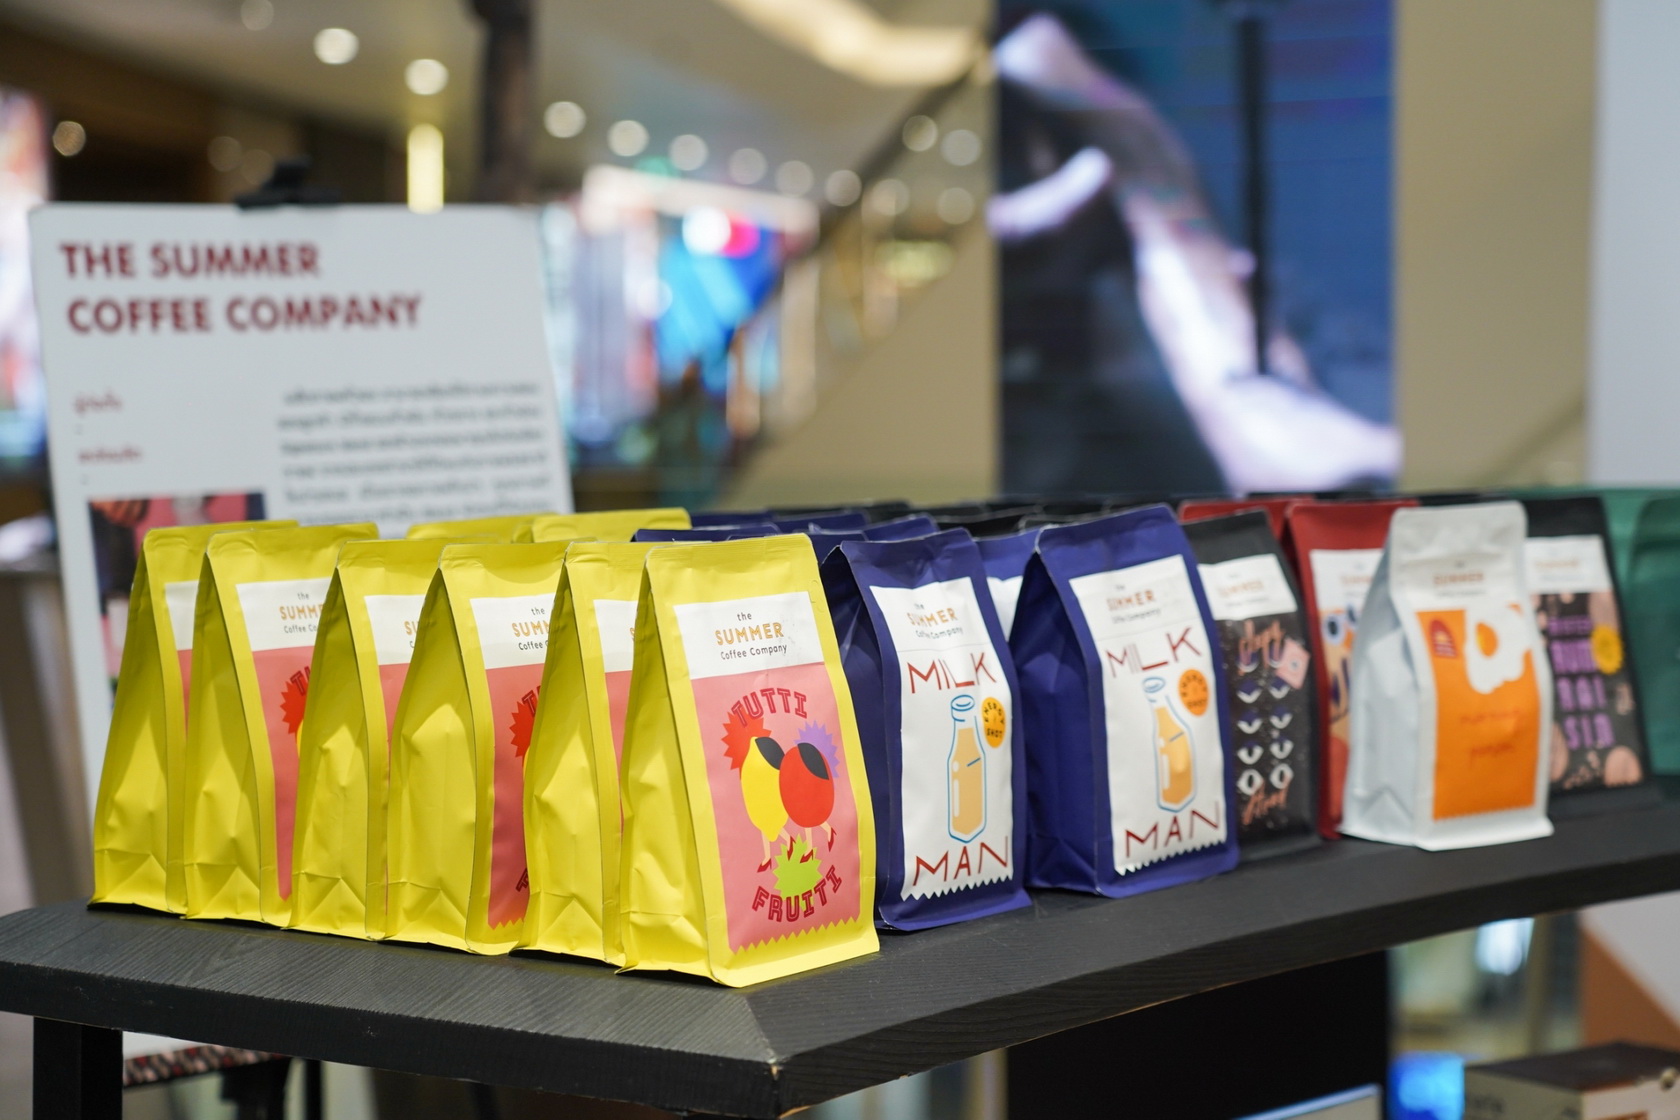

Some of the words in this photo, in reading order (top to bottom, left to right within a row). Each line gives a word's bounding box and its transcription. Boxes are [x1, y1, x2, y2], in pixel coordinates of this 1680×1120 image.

[60, 243, 134, 278] THE
[151, 243, 320, 278] SUMMER
[67, 297, 210, 334] COFFEE
[225, 293, 421, 332] COMPANY
[296, 591, 310, 600] the
[530, 605, 545, 616] the
[283, 624, 306, 634] Coffee
[714, 621, 785, 646] SUMMER
[736, 612, 752, 622] the
[518, 640, 544, 651] Coffee
[720, 649, 747, 661] Coffee
[749, 644, 788, 657] Company
[1105, 627, 1203, 679] MILK
[907, 652, 997, 695] MILK
[730, 687, 808, 729] TUTTI
[1125, 801, 1219, 859] MAN
[912, 836, 1009, 887] MAN
[752, 865, 843, 923] FRUITI
